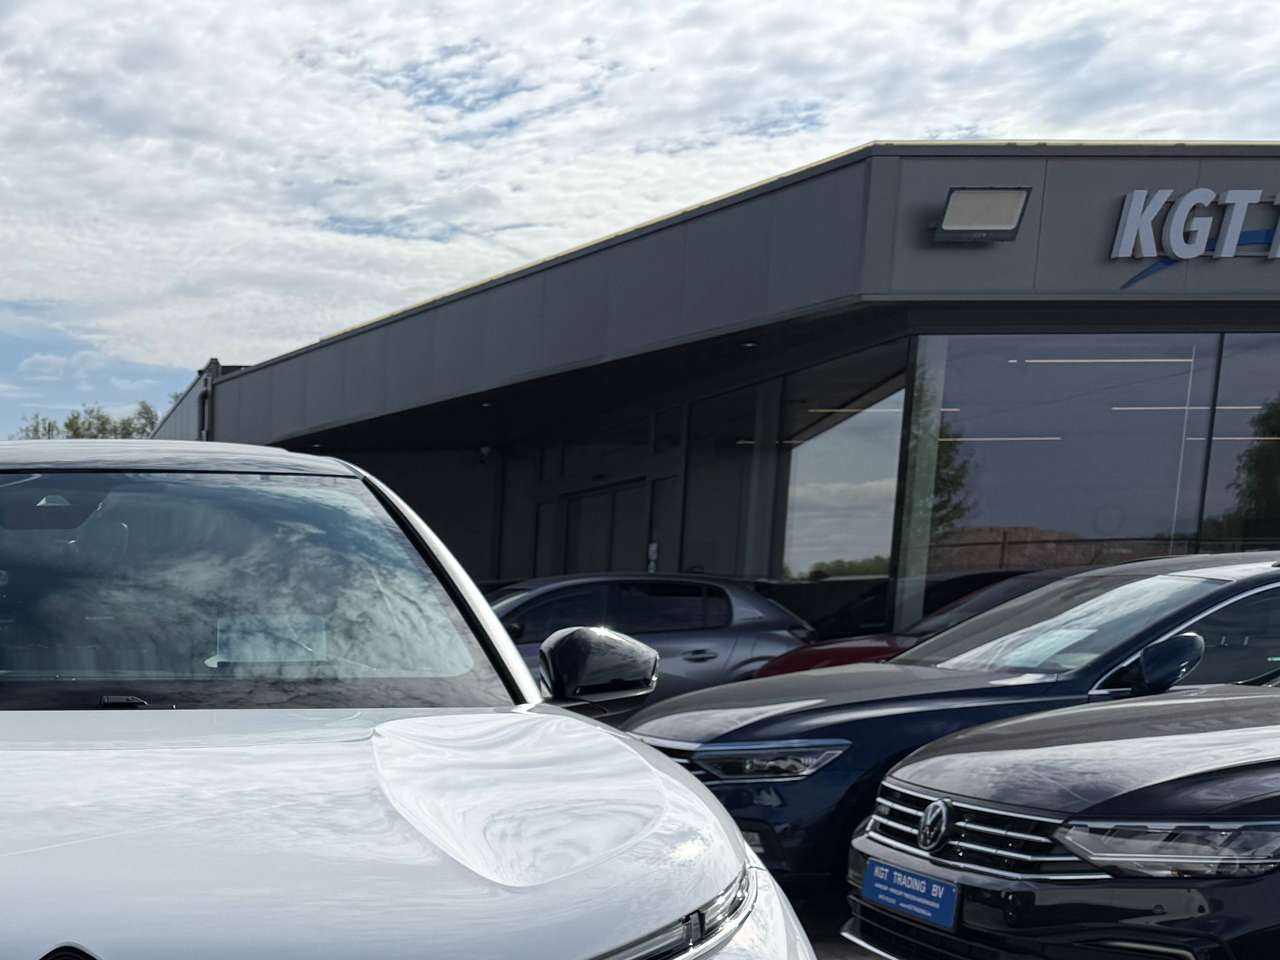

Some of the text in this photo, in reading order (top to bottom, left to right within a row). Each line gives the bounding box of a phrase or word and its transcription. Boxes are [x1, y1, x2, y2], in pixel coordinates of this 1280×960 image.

[1111, 187, 1263, 260] KGT
[893, 871, 926, 893] TRADING
[931, 884, 944, 898] BV
